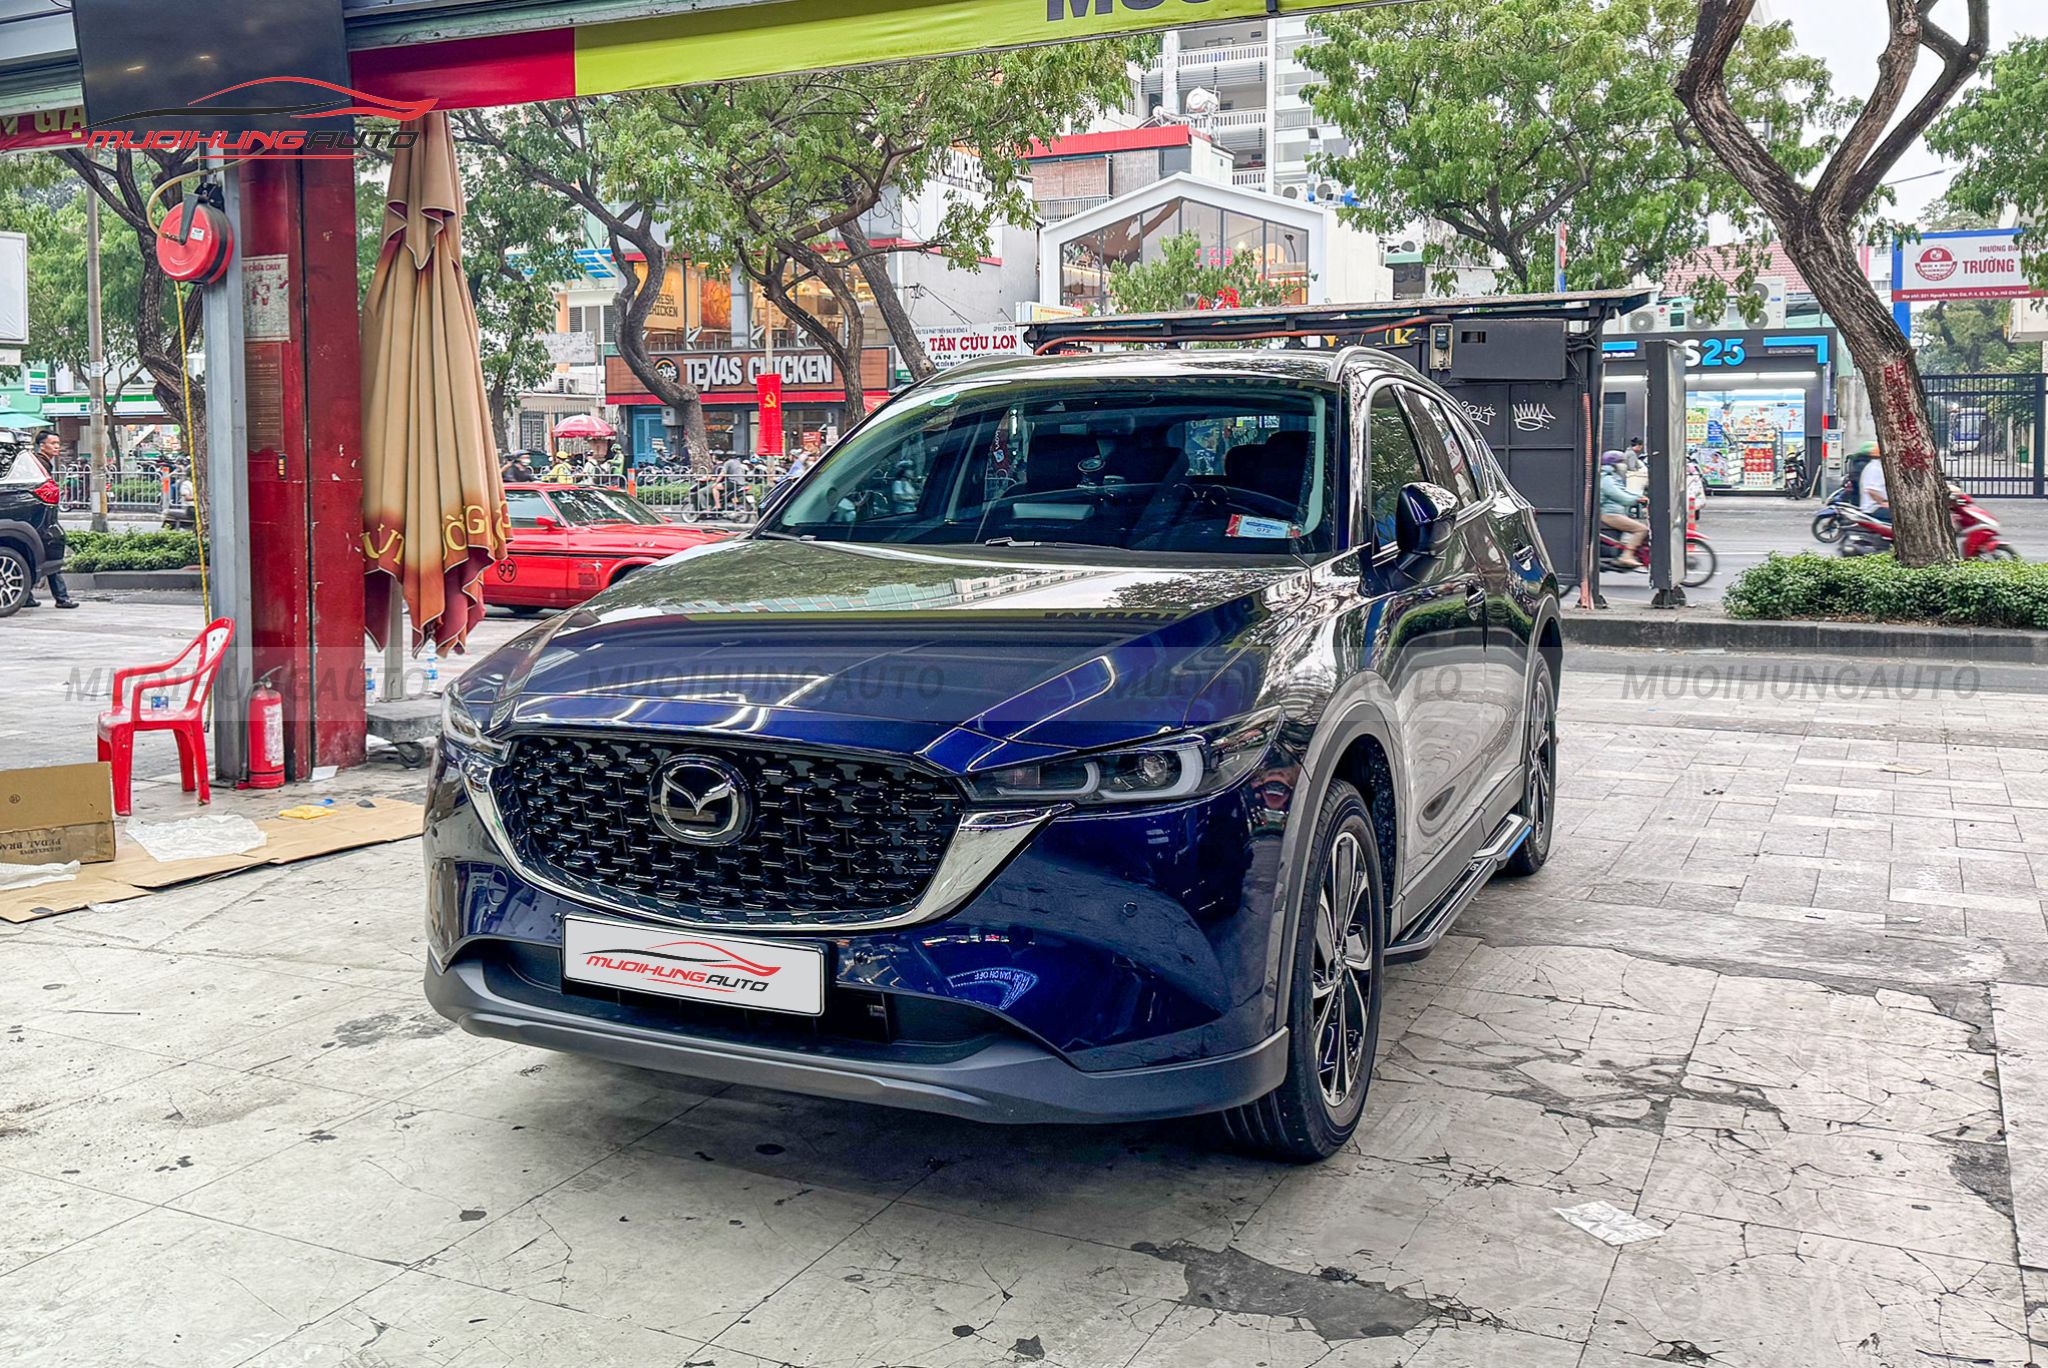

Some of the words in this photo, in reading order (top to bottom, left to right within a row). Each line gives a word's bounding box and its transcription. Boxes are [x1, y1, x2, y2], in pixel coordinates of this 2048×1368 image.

[929, 335, 956, 351] TÂN
[960, 332, 989, 350] CỬU
[683, 355, 743, 391] TEXAS
[748, 355, 833, 385] CHICKEN
[500, 562, 514, 578] 99
